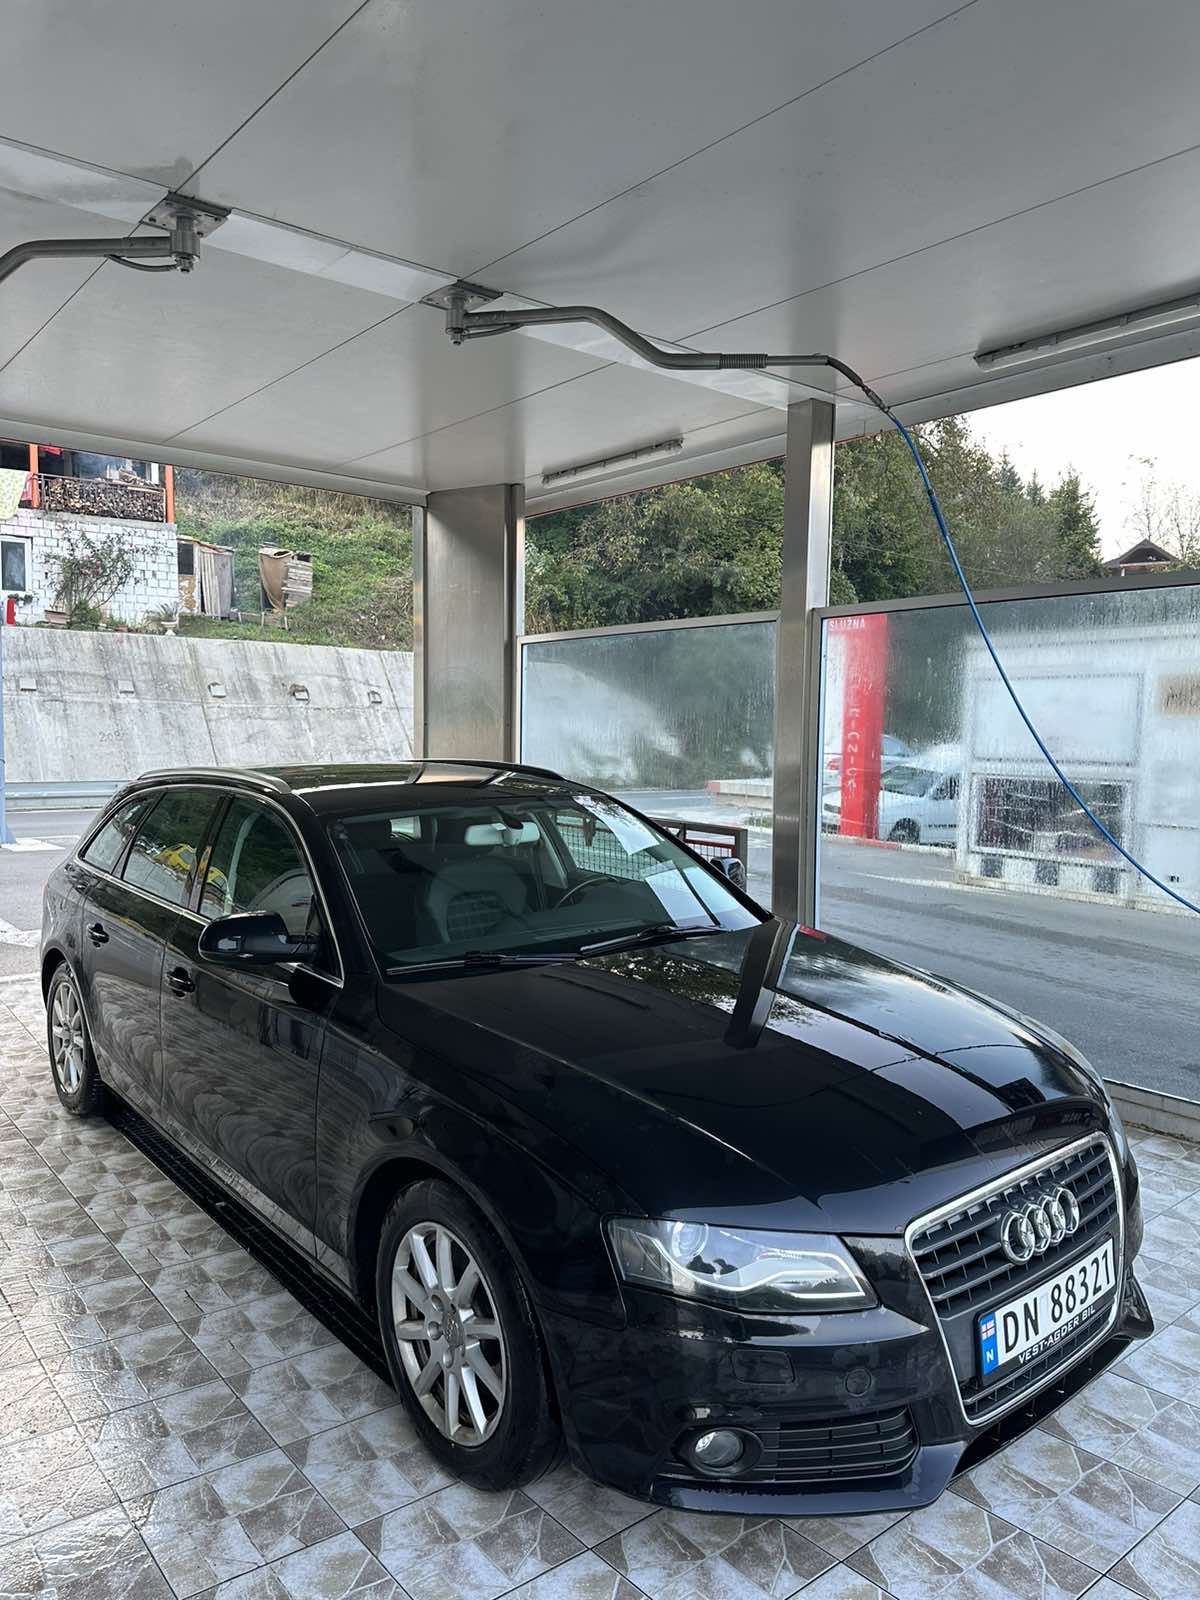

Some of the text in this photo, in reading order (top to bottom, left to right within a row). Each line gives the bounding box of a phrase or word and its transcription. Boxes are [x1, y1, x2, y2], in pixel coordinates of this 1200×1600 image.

[1003, 1249, 1110, 1353] DN 88321
[986, 1349, 994, 1362] N
[1018, 1305, 1096, 1364] VEST-AGDER BIL
